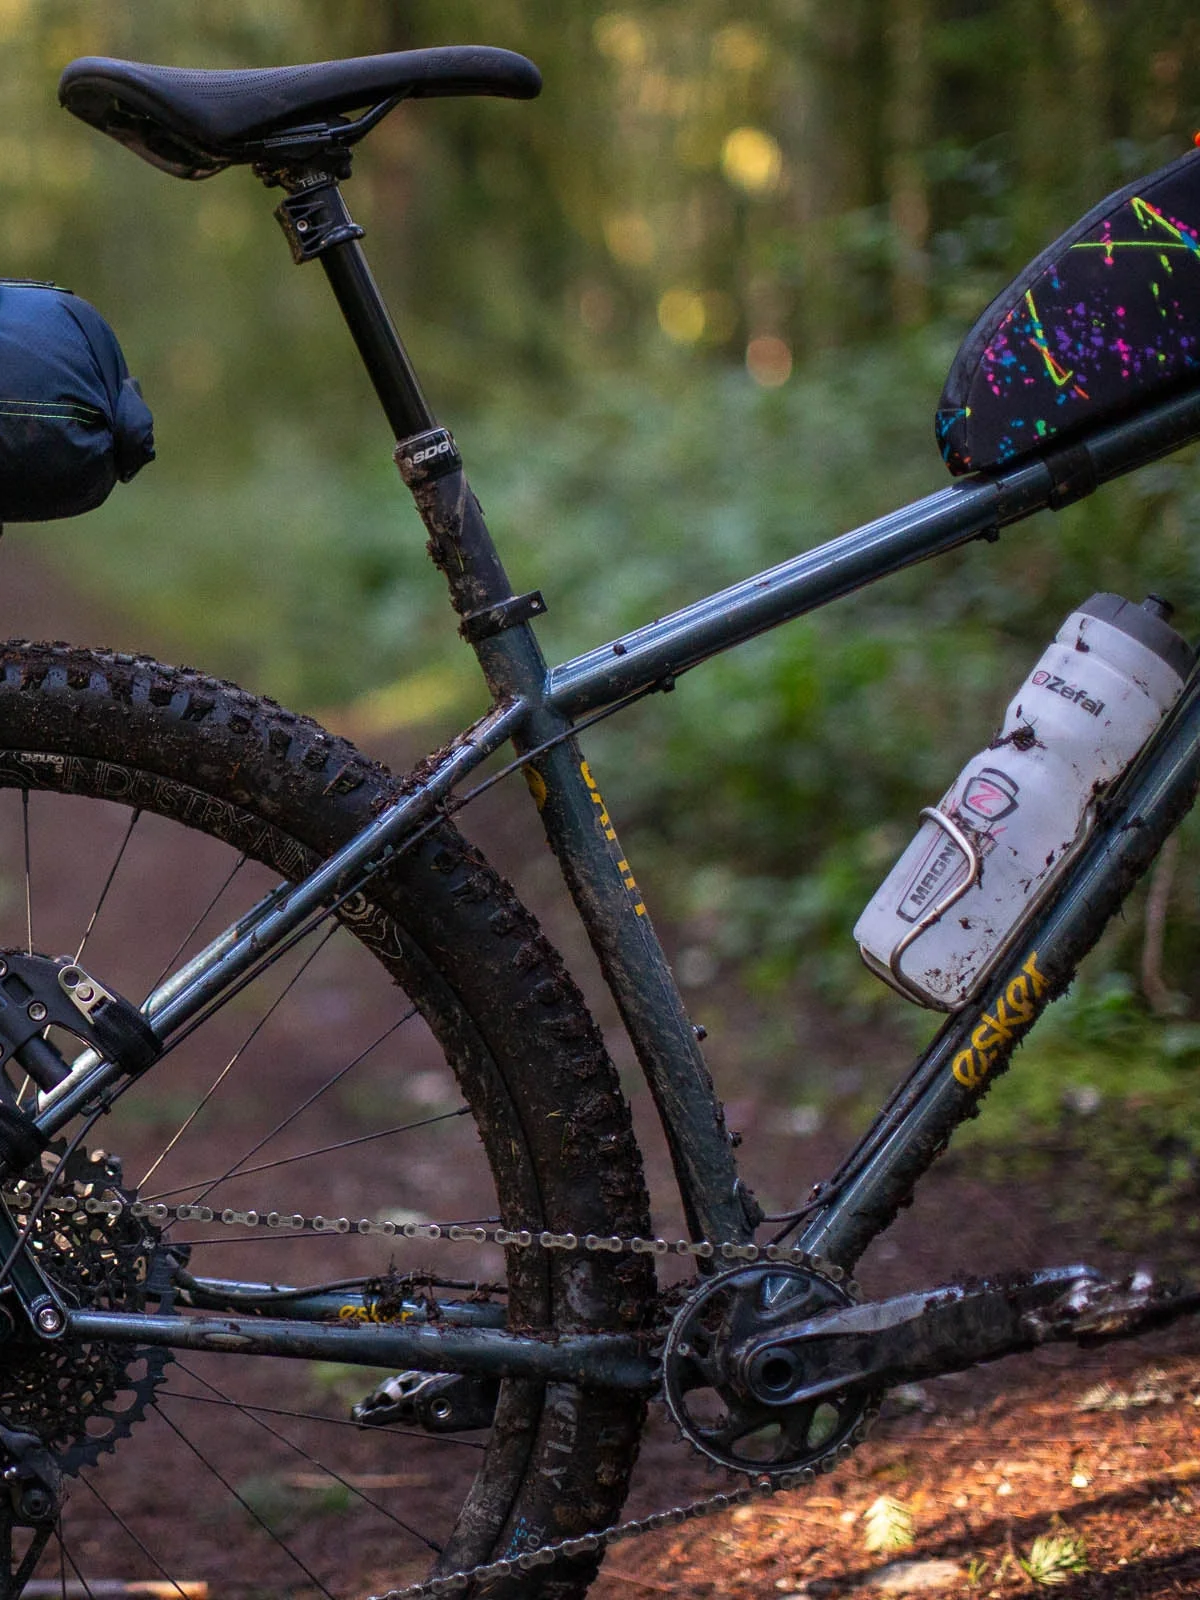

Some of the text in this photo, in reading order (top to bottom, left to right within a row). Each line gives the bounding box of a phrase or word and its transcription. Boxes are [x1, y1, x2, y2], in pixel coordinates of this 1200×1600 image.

[413, 441, 450, 465] SDG
[252, 825, 312, 880] NIN
[909, 815, 976, 907] MAGNM
[952, 950, 1051, 1089] esker
[338, 1304, 414, 1323] esr
